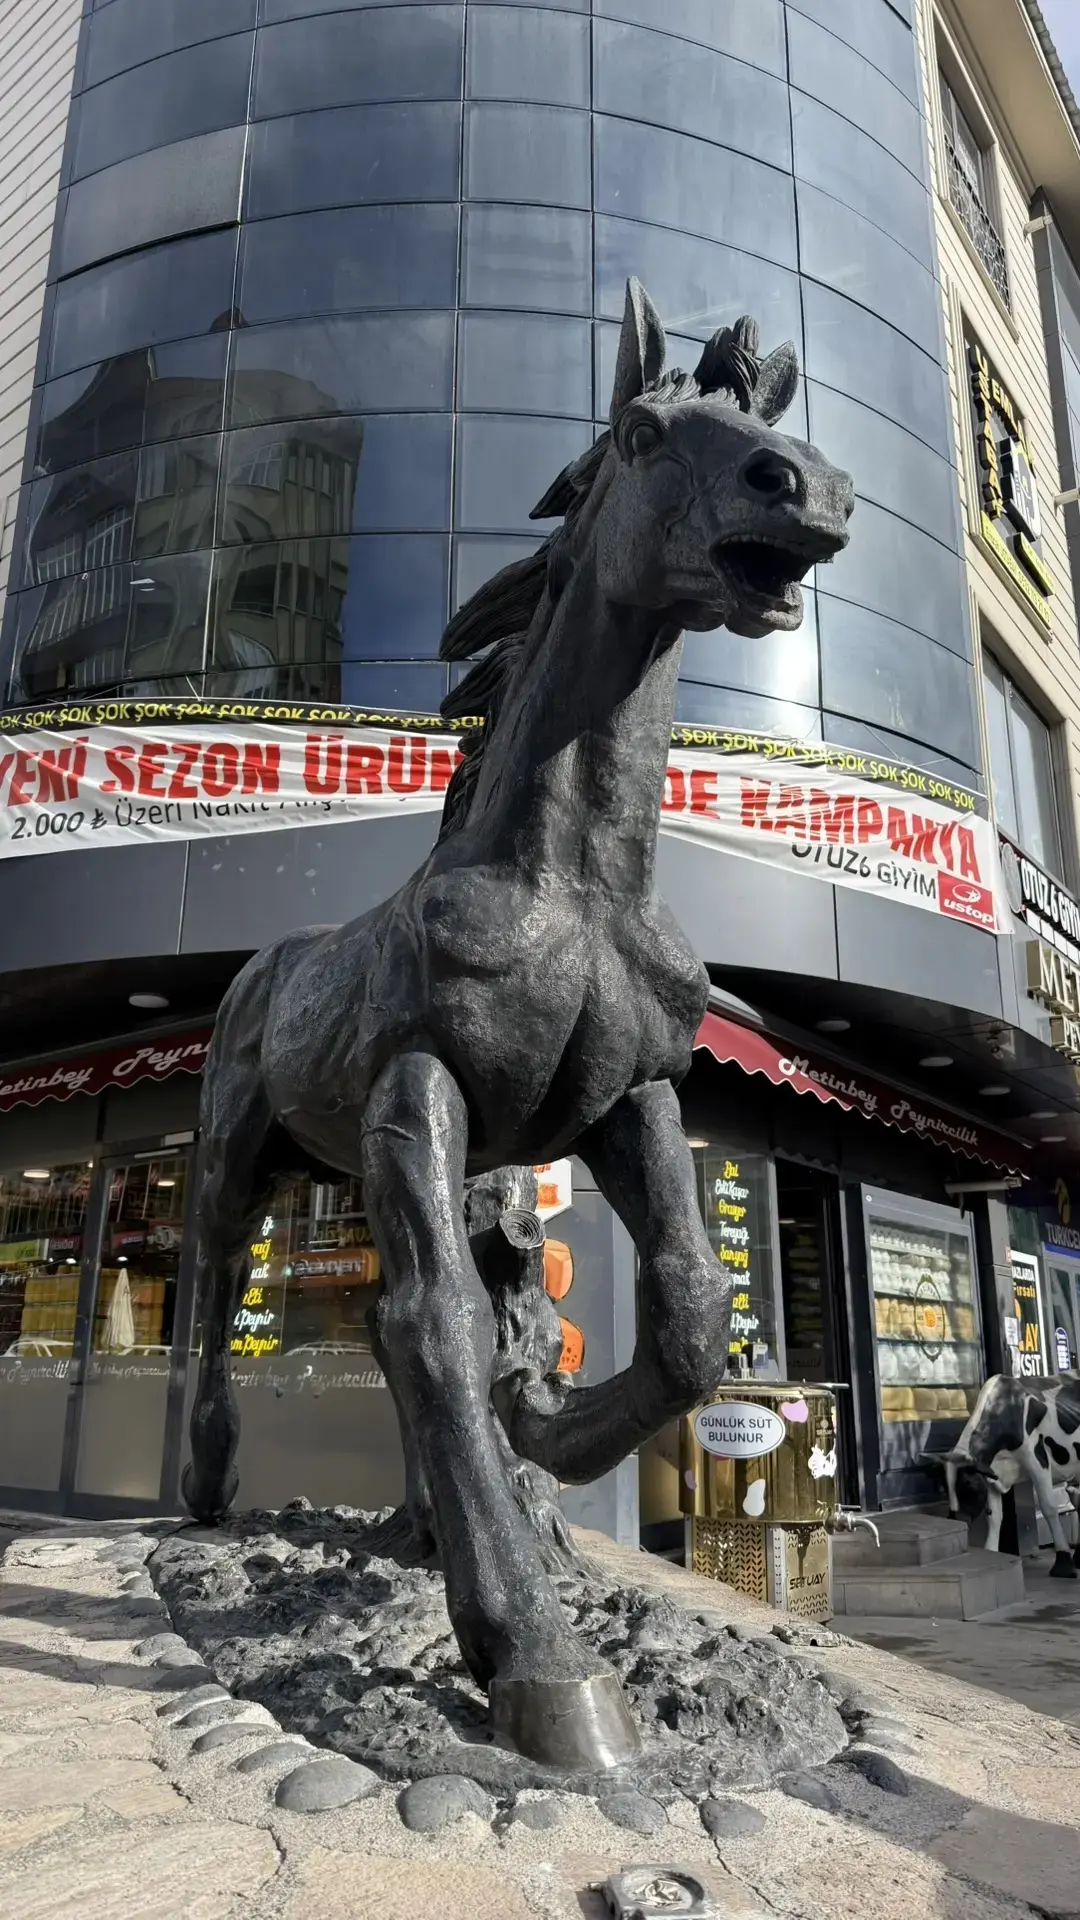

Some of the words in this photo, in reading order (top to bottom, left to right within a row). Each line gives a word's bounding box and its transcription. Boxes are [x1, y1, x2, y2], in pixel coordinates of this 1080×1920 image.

[23, 711, 53, 729] ŞOK
[58, 707, 91, 727] ŞOK
[95, 704, 130, 725] ŞOK
[134, 703, 171, 722] ŞOK
[680, 727, 718, 746] ŞOK
[722, 732, 759, 752] ŞOK
[763, 738, 797, 759] ŞOK
[837, 752, 866, 774] ŞOK
[869, 760, 899, 782] ŞOK
[900, 770, 927, 792] ŞOK
[928, 780, 952, 801] ŞOK
[953, 789, 976, 810] ŞOK
[11, 811, 85, 840] 2.000
[114, 797, 182, 827] Üzeri
[99, 742, 280, 799] SEZON
[739, 776, 982, 884] KAMPANYA
[877, 860, 937, 900] GİYİM
[944, 899, 994, 925] ustop
[0, 1067, 93, 1095] etinbey
[778, 1055, 879, 1111] Metinbey
[890, 1100, 979, 1146] Peynircilik
[239, 1308, 275, 1332] Peynir
[242, 1333, 279, 1357] Peynir
[700, 1416, 746, 1429] GÜNLÜK
[748, 1417, 772, 1429] SÜT
[708, 1431, 764, 1443] BULUNUR
